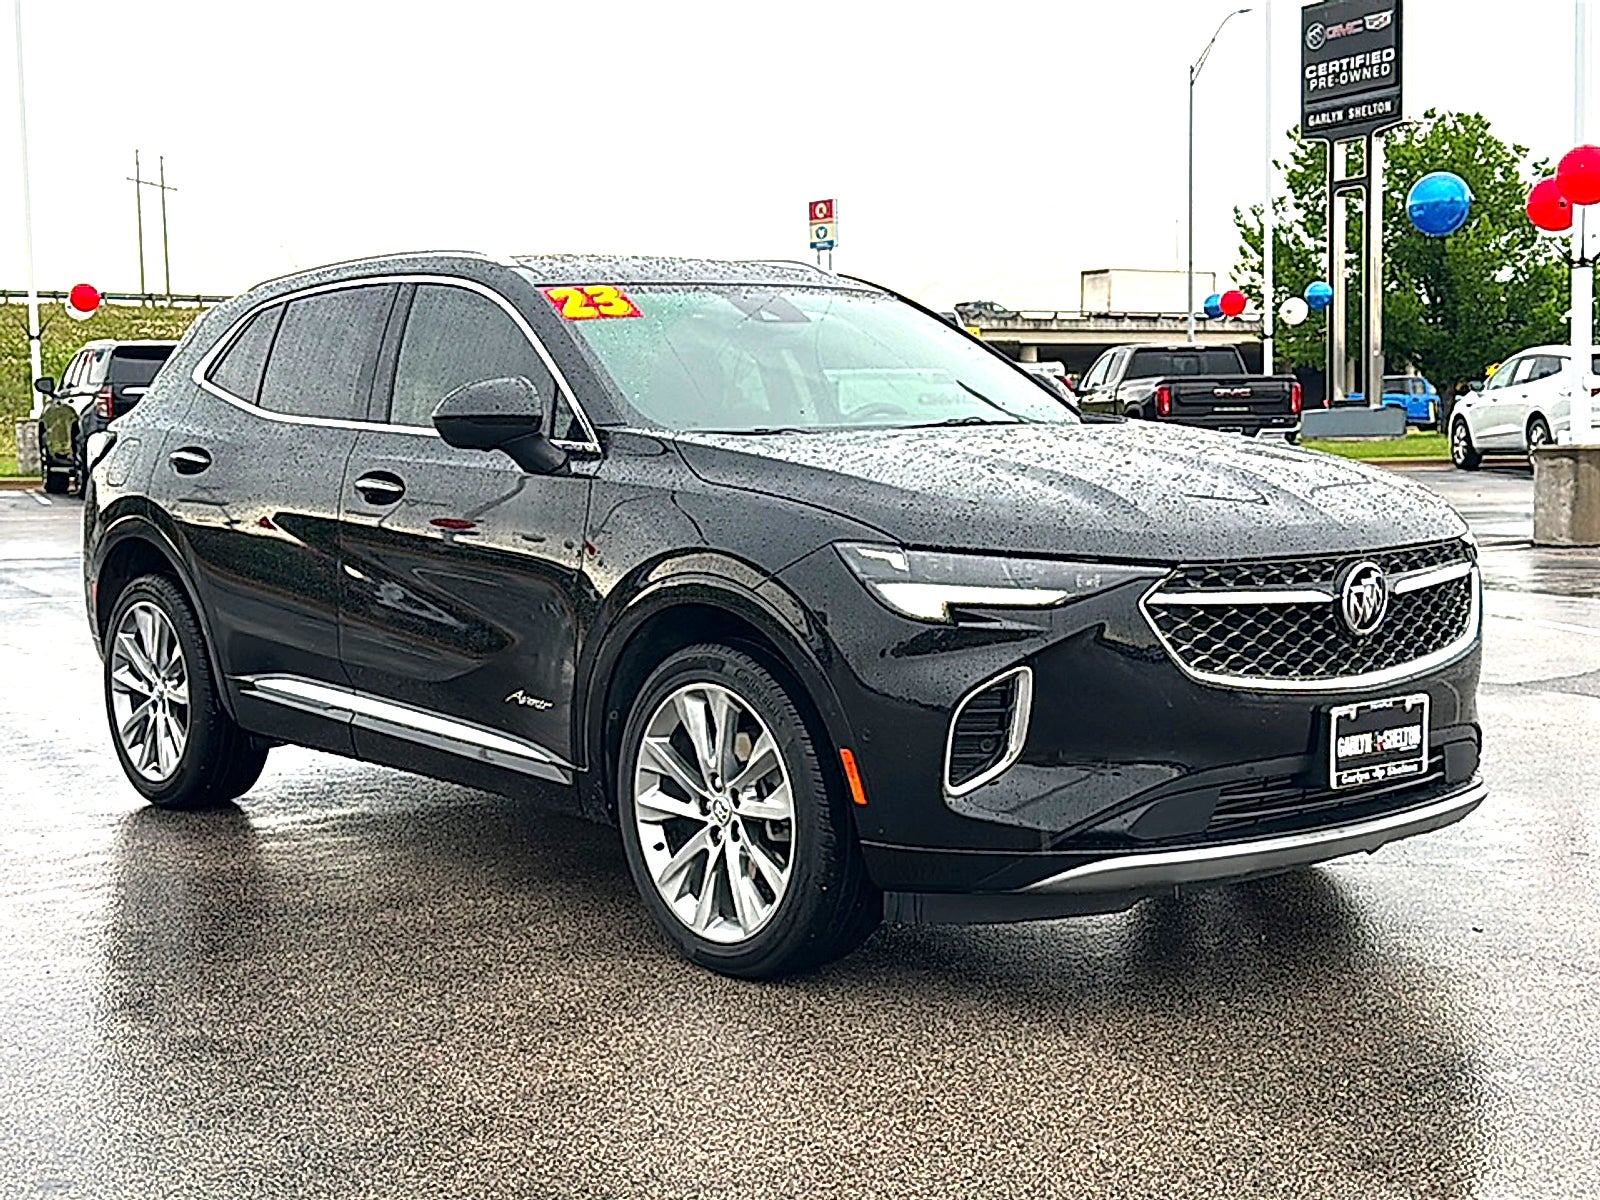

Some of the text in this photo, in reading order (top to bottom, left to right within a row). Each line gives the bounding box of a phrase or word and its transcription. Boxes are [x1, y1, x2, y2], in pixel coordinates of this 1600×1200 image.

[1326, 19, 1364, 40] GMC
[1305, 47, 1396, 79] CERTIFIED
[1309, 63, 1391, 91] PRE-OWNED
[1308, 100, 1392, 127] GARLYN SHELTON
[547, 285, 634, 318] 23
[1213, 388, 1252, 398] GMC
[1382, 724, 1421, 750] SHELTON
